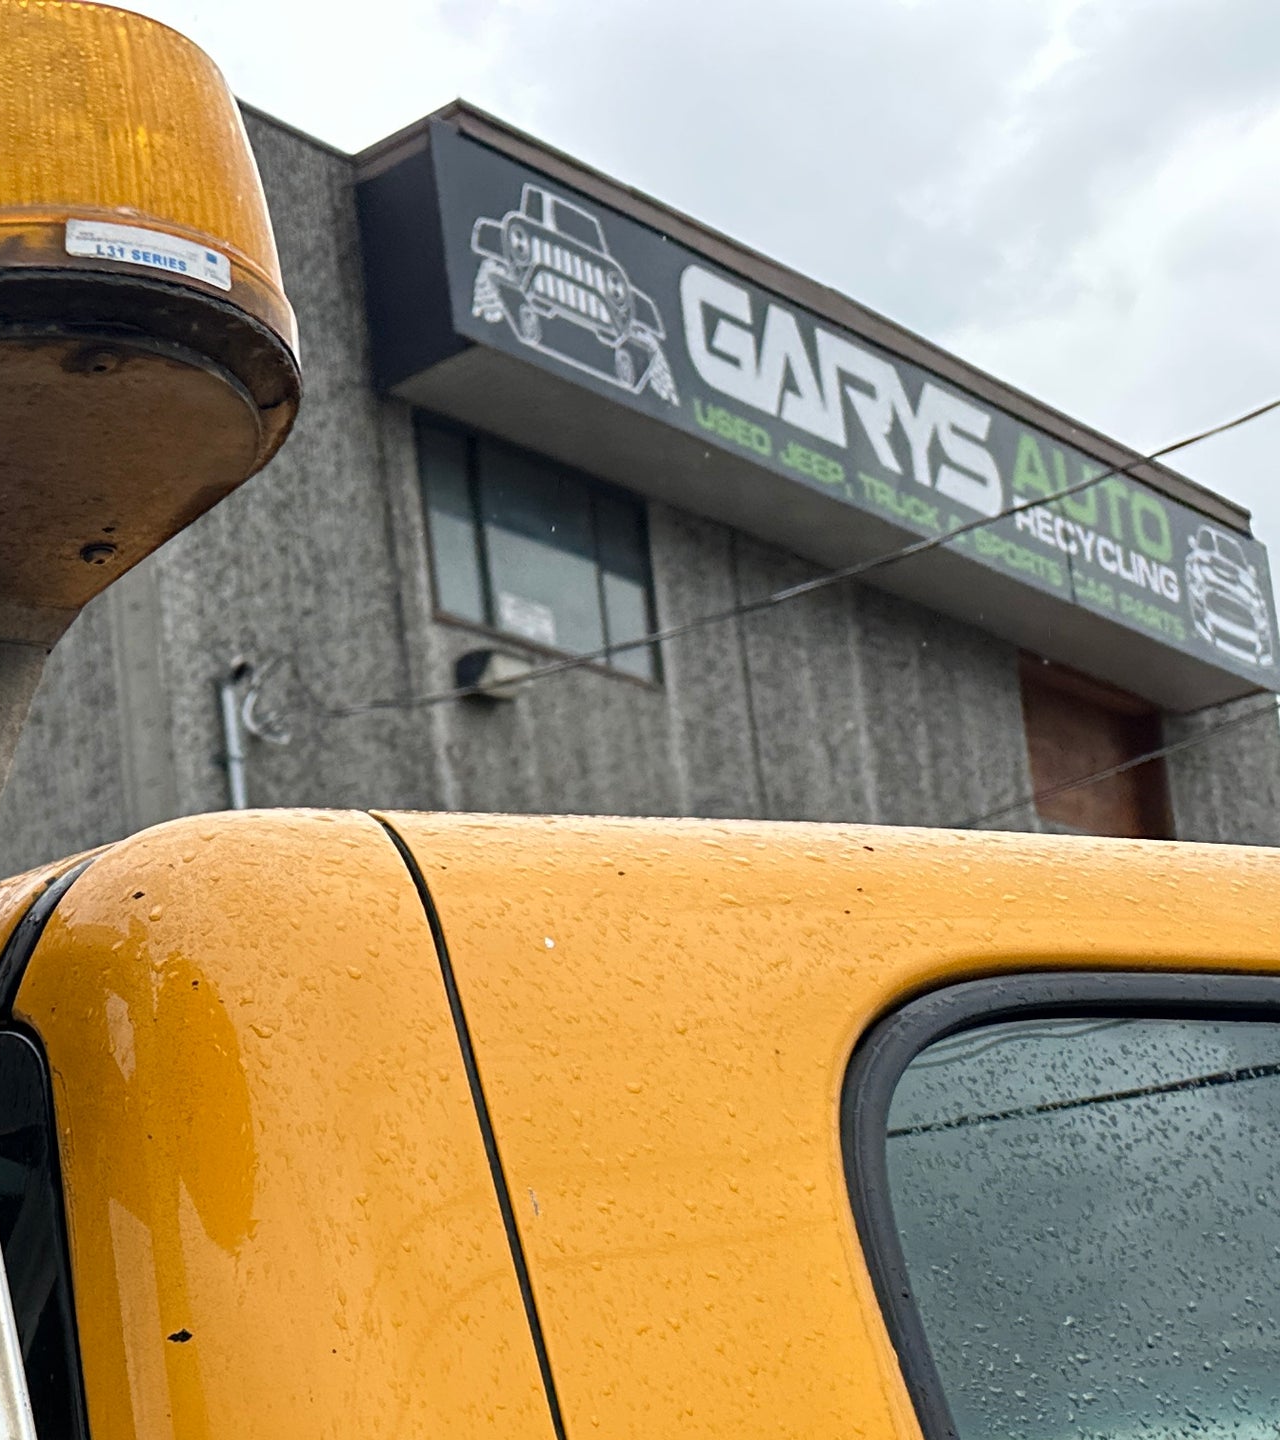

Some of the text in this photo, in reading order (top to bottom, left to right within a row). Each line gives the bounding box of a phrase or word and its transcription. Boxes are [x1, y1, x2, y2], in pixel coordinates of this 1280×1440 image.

[96, 243, 126, 259] L31
[131, 249, 188, 273] SERIES
[680, 263, 1173, 563] GARYS AUTO
[693, 399, 773, 458] USED
[858, 471, 941, 531] TRUCK
[973, 527, 1064, 588] SPORTS
[1071, 569, 1117, 610] CAR
[1119, 591, 1187, 642] PARTS
[1013, 494, 1181, 603] RECYCLING
